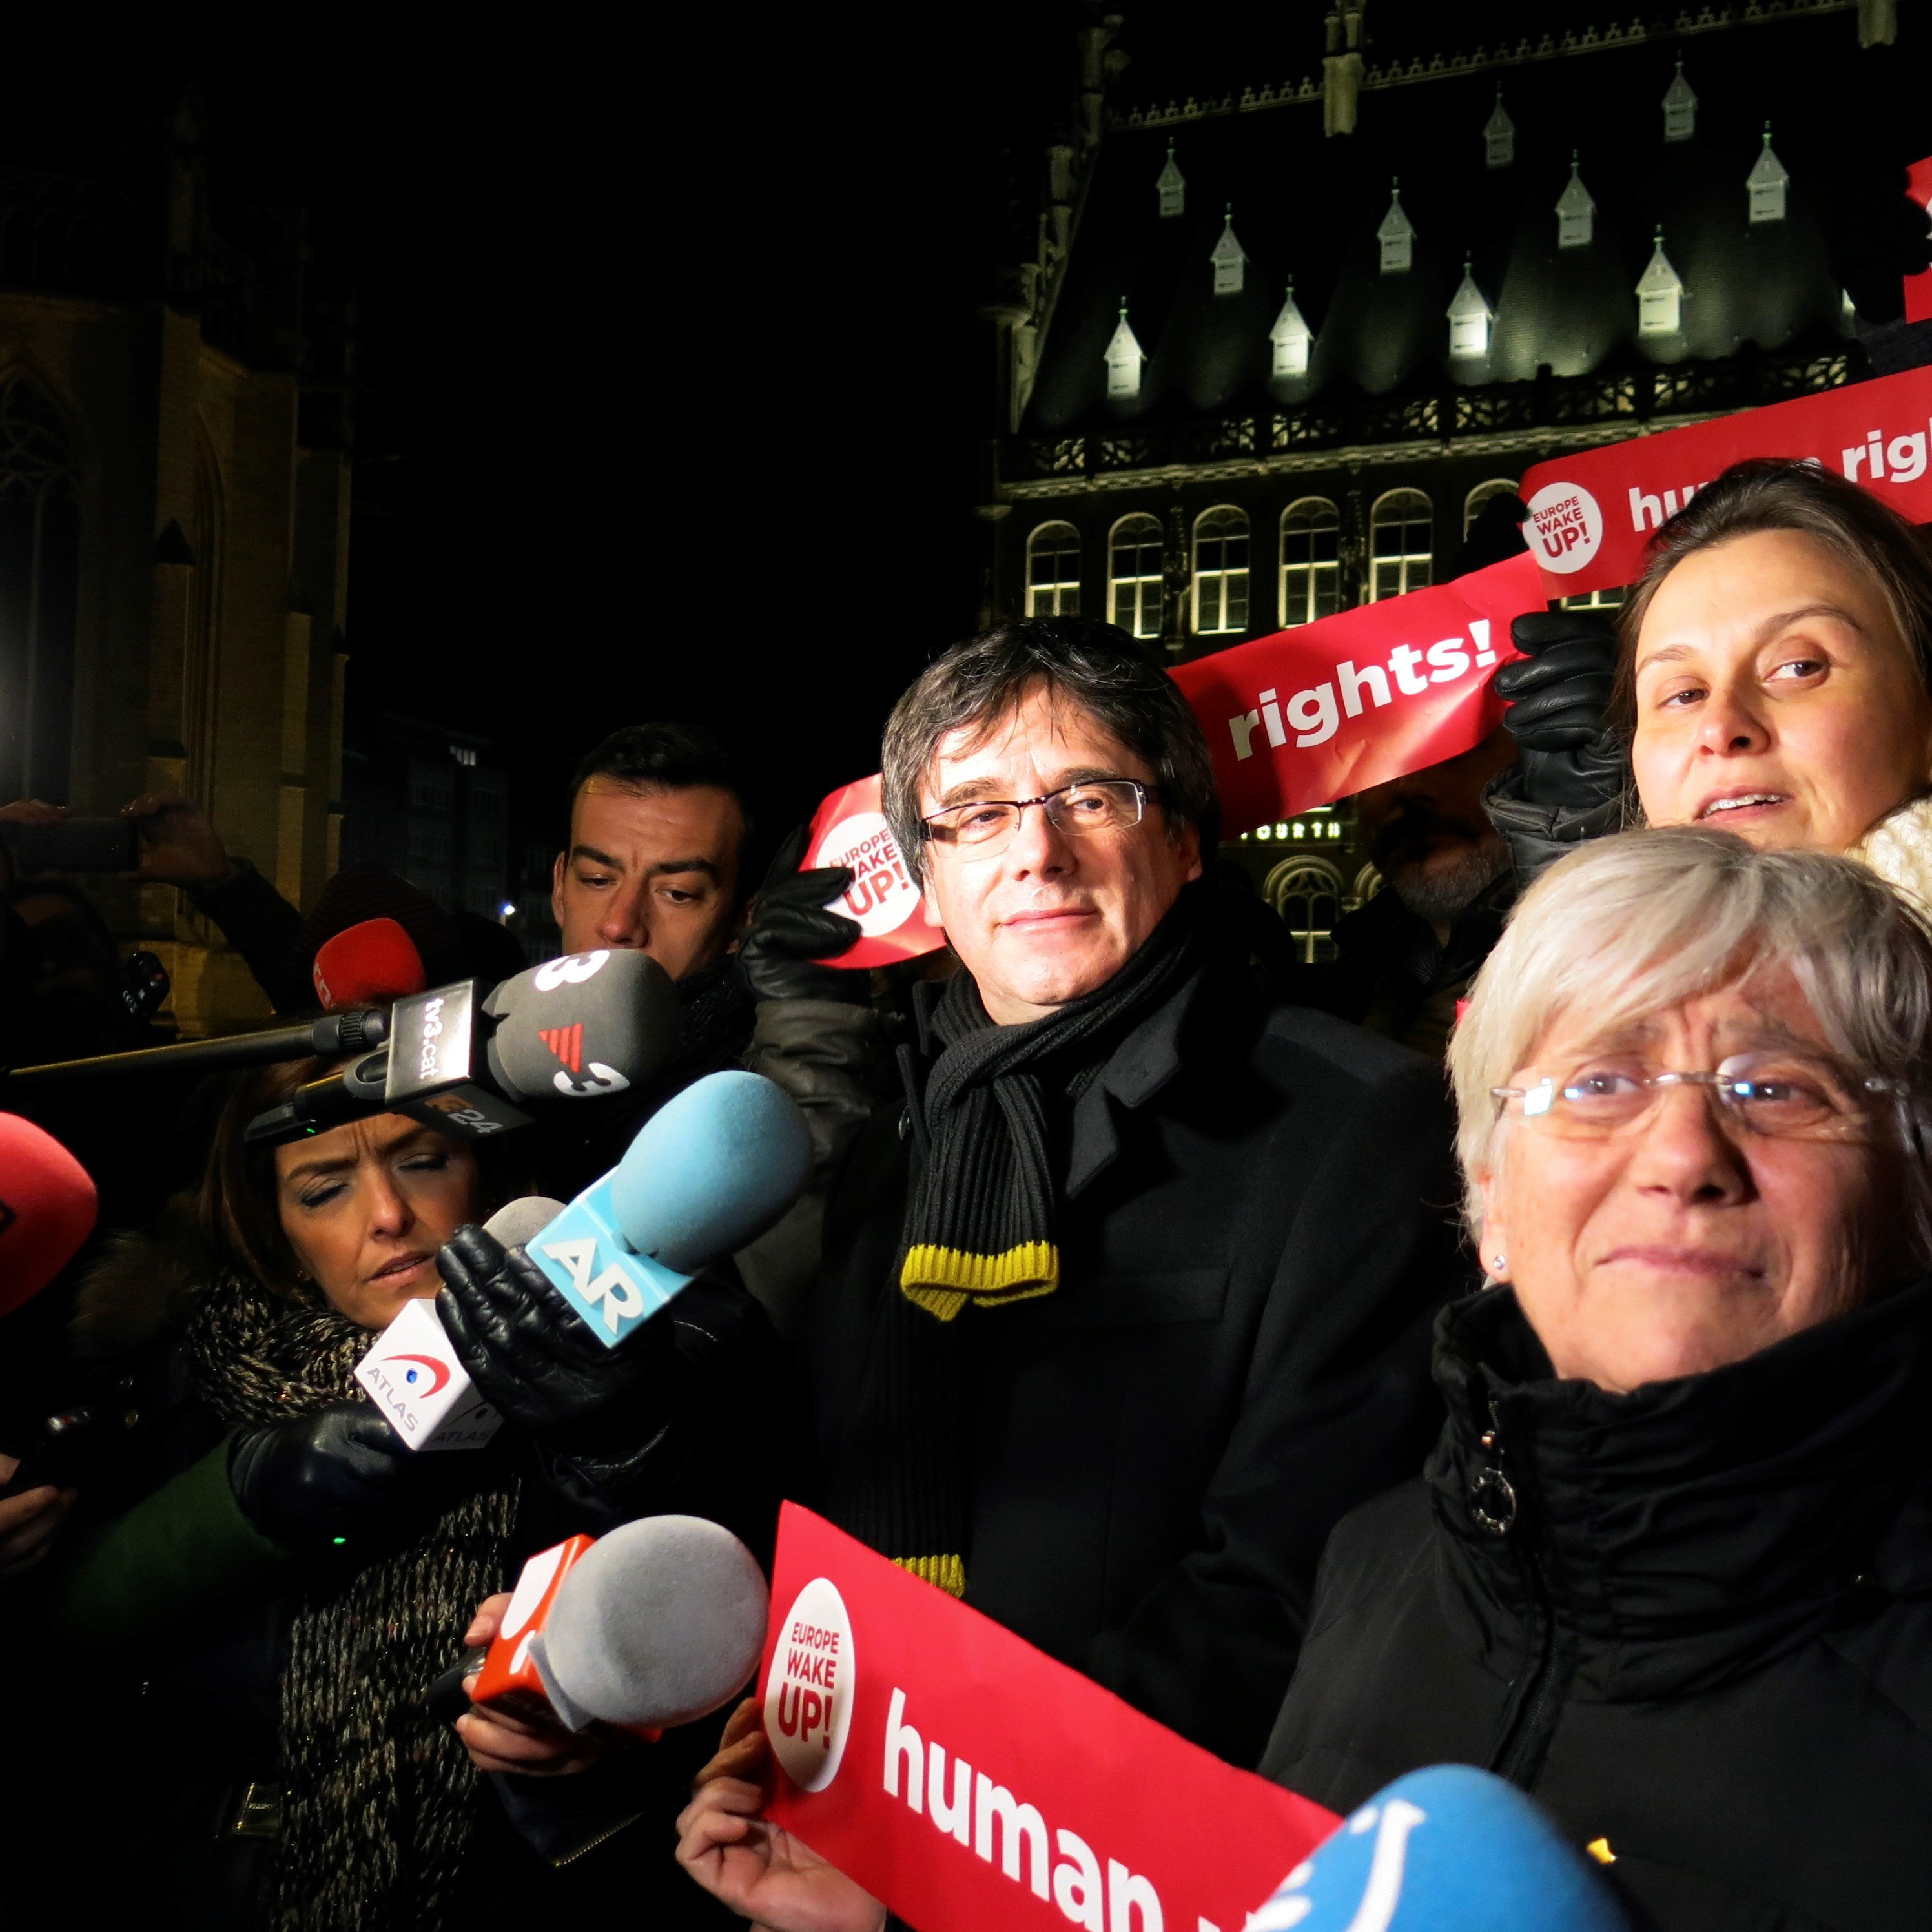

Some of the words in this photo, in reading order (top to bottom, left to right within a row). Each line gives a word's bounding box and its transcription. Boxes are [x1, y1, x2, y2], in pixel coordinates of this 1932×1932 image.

[1842, 416, 1932, 483] rig
[1533, 495, 1579, 523] EUROPE
[1537, 507, 1583, 535] WAKE
[1542, 521, 1590, 558] UP!
[1229, 619, 1496, 761] rights!
[1240, 821, 1340, 840] OURTH
[844, 861, 909, 916] UP!
[420, 998, 444, 1080] tv3.cat
[541, 1238, 643, 1335] AR
[367, 1368, 419, 1432] ATLAS
[792, 1621, 839, 1654] EUROPE
[787, 1647, 836, 1689] WAKE
[778, 1681, 833, 1750] UP!
[883, 1687, 1164, 1932] human
